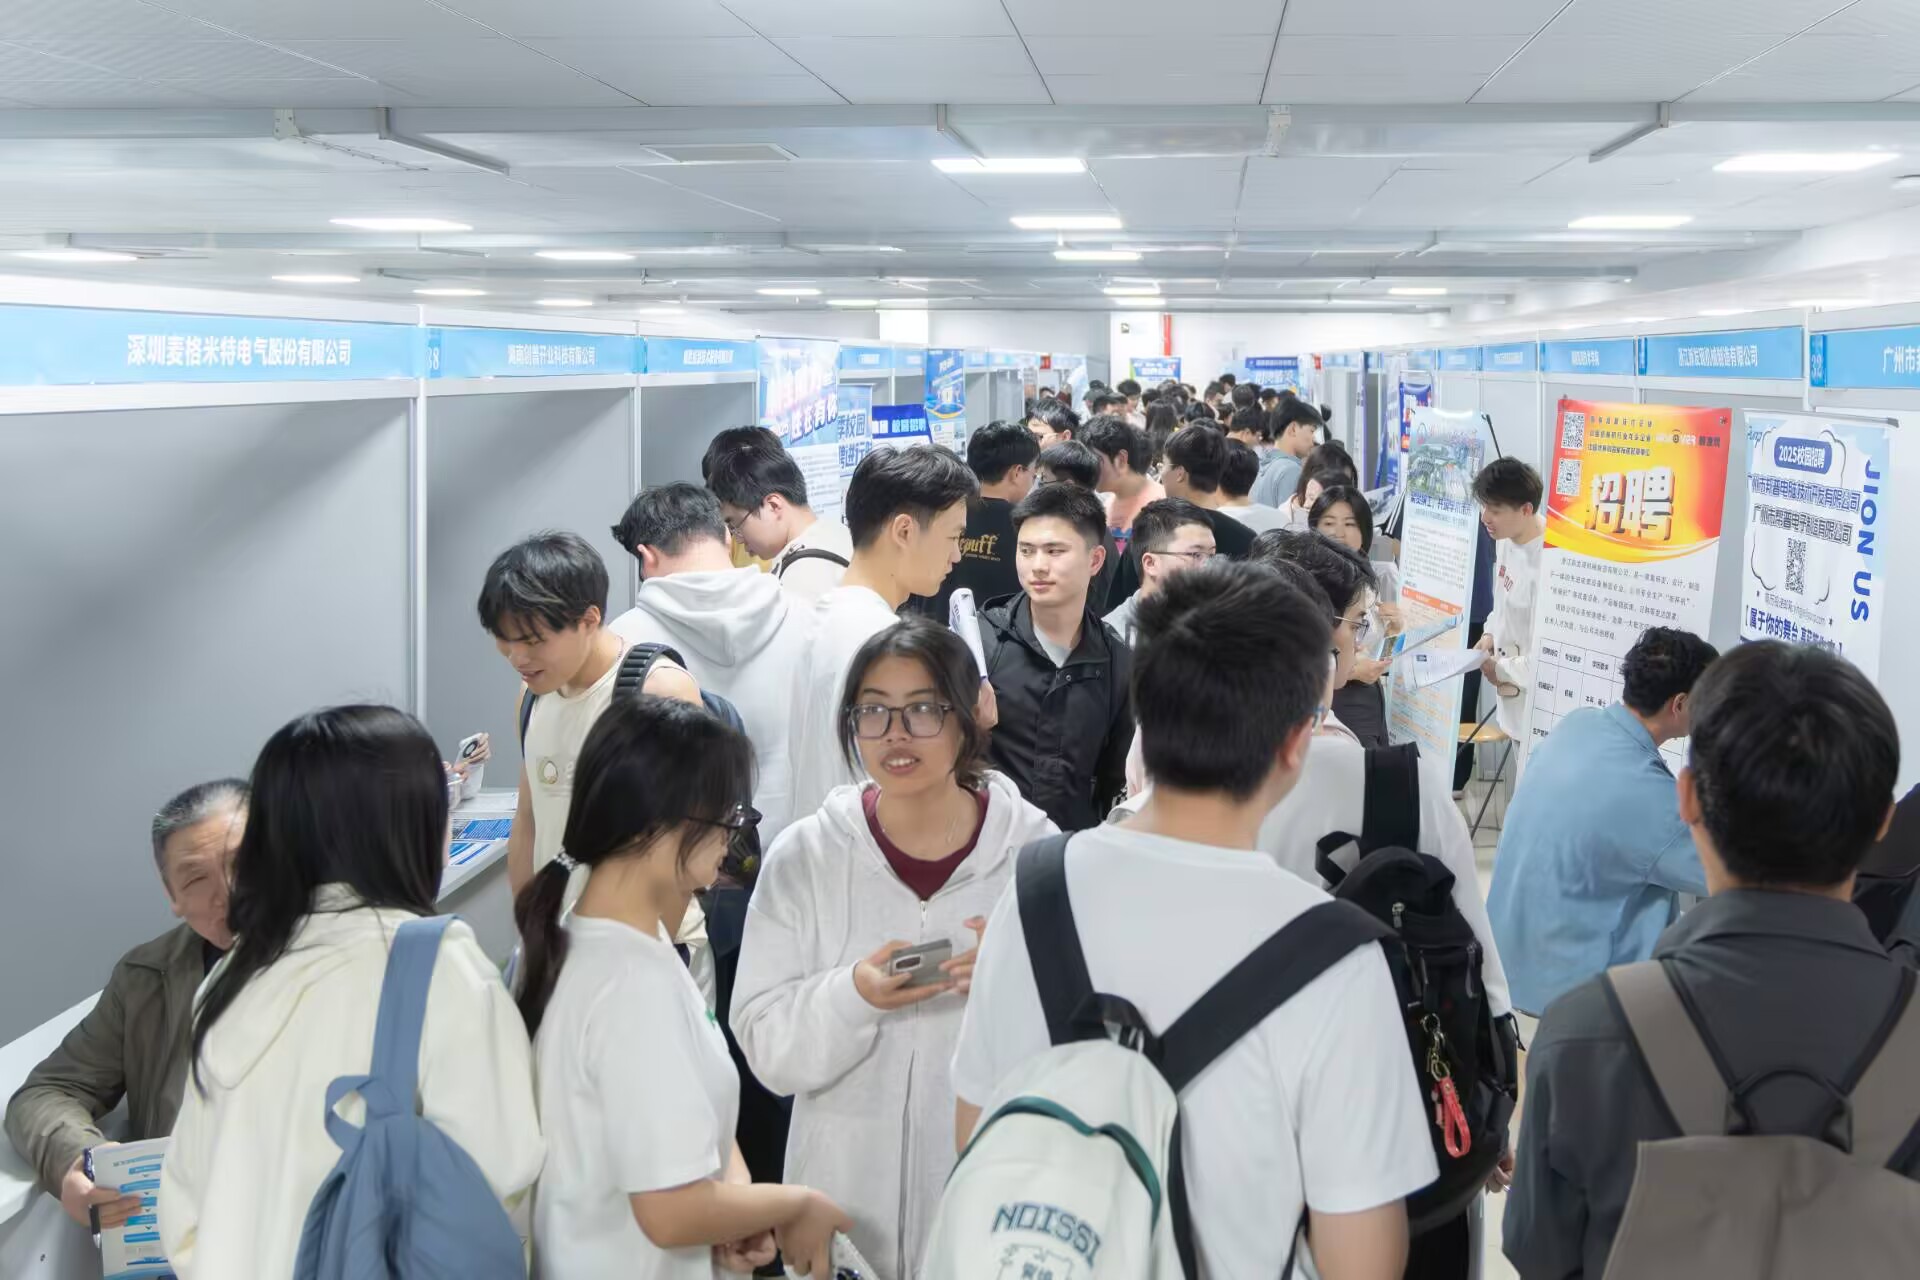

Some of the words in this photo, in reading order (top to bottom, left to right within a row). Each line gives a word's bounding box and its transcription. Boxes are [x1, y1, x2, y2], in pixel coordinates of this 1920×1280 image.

[127, 334, 352, 367] 深圳麦格米特电气股份有限公司
[1778, 445, 1825, 469] 2025校园招聘
[1584, 466, 1675, 541] 招聘
[1857, 459, 1881, 556] JION
[1851, 571, 1872, 622] US
